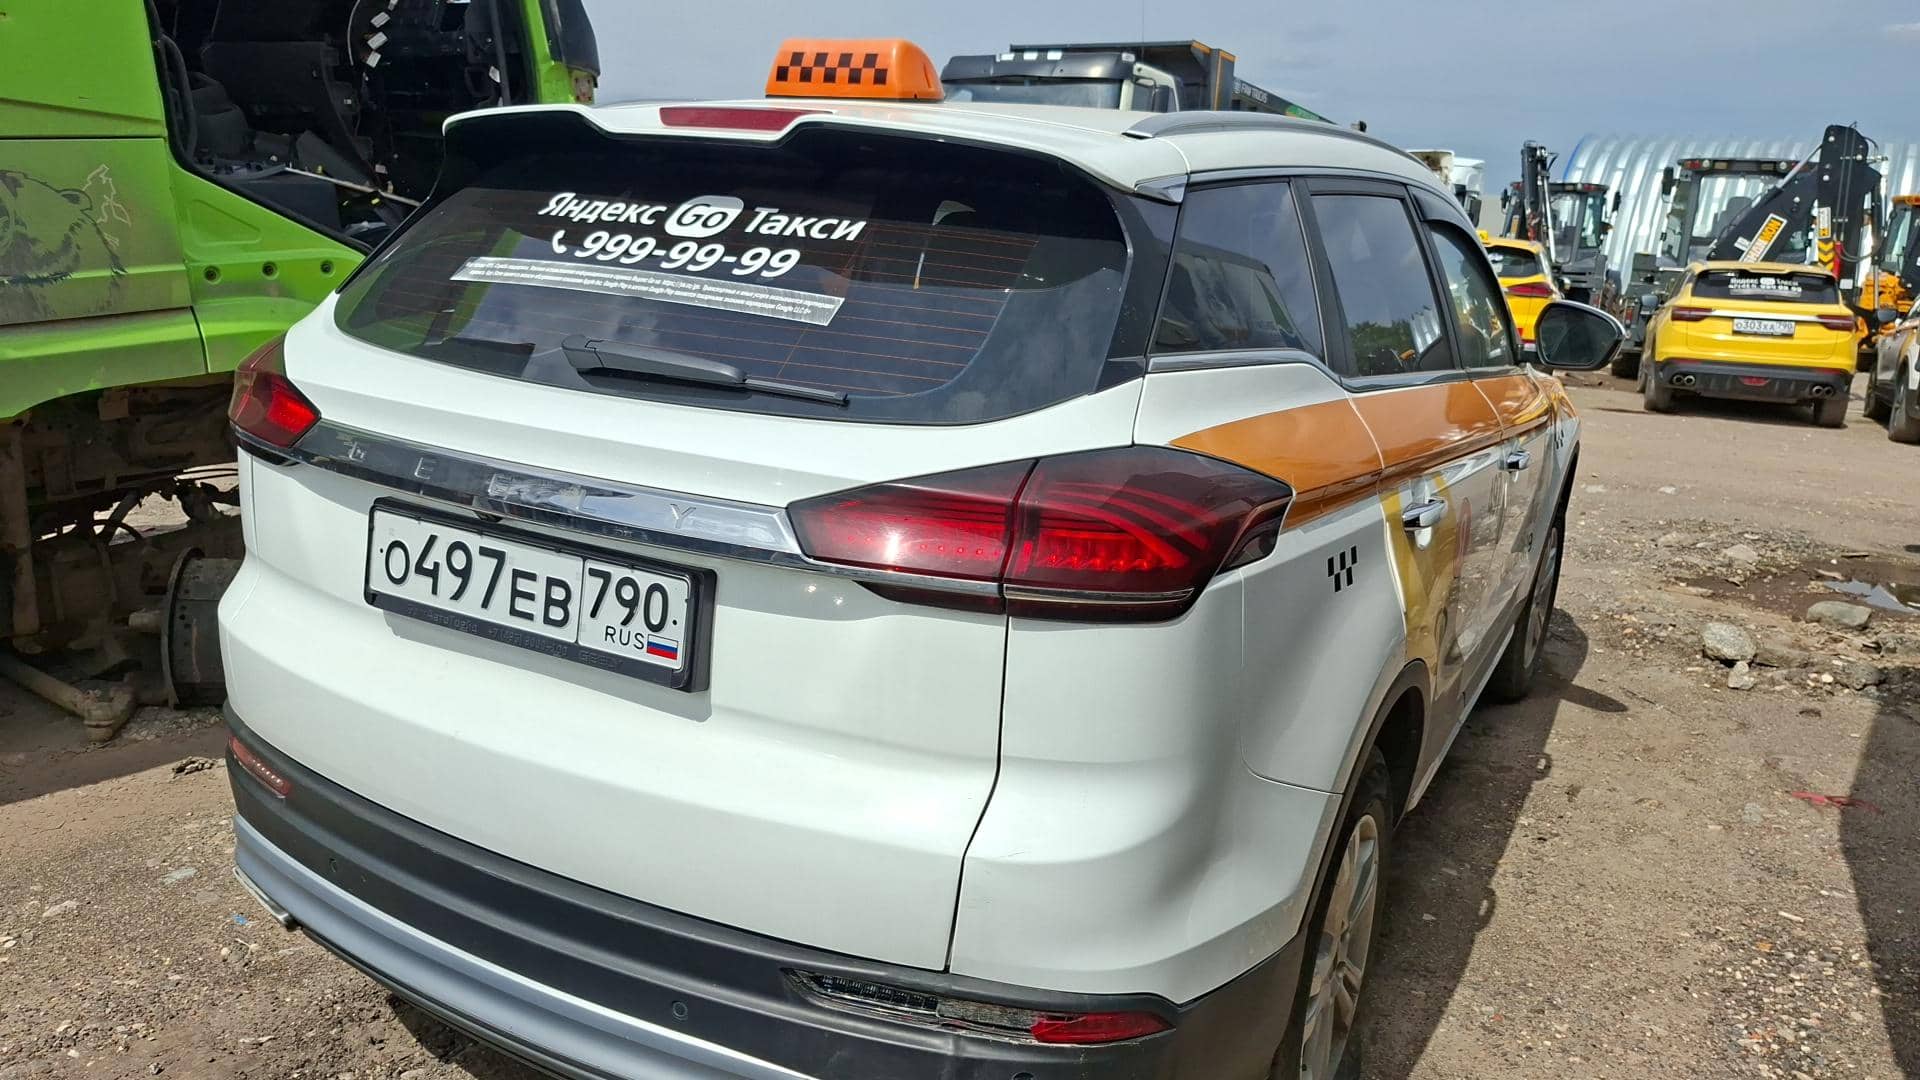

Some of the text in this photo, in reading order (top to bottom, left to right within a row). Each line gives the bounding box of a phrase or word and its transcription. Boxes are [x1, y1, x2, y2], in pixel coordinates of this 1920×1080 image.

[538, 192, 667, 226] Яндекс
[744, 207, 866, 241] Такси
[574, 231, 801, 278] 999-99-99
[588, 568, 668, 633] 790
[605, 626, 645, 650] RUS
